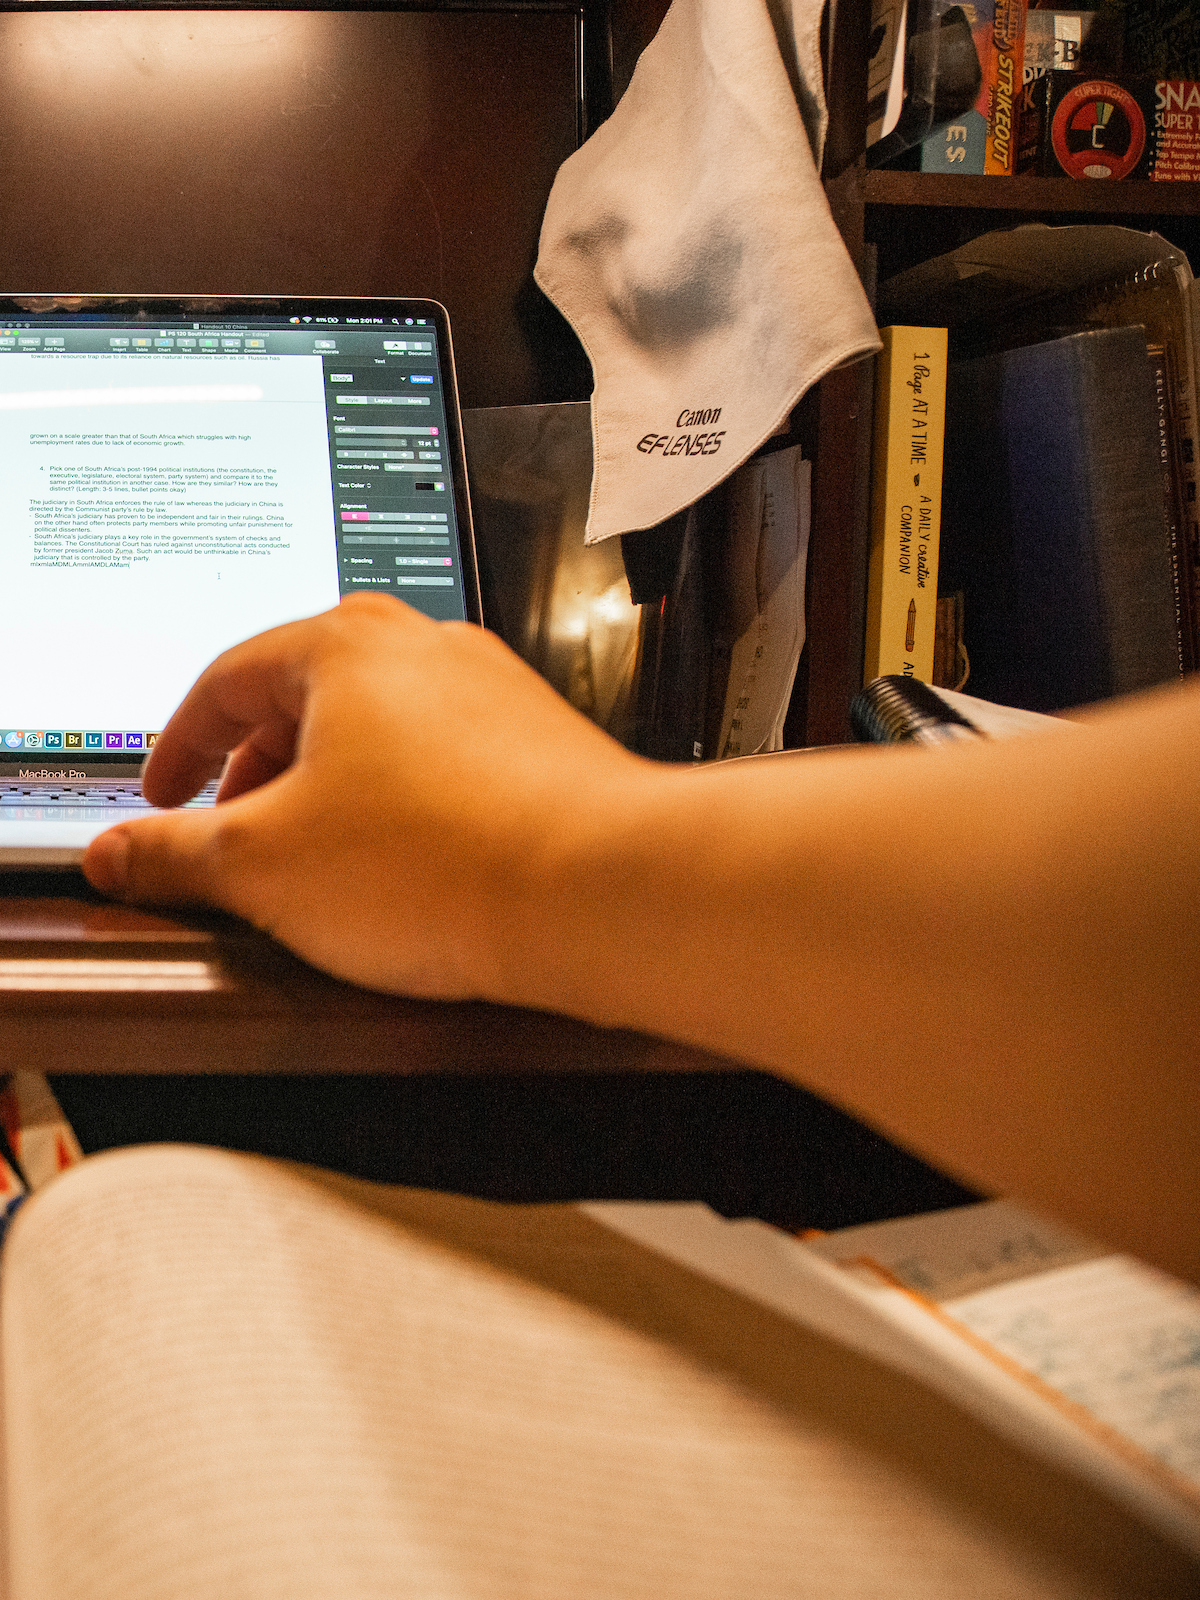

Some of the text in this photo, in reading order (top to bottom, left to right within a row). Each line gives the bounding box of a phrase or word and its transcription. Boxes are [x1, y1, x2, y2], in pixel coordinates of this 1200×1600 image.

[1074, 85, 1100, 98] SUPER
[994, 54, 1013, 169] STRIKEOUT
[1154, 112, 1192, 130] SUPER
[1157, 130, 1193, 142] Extremely
[1156, 139, 1171, 148] and
[1156, 150, 1193, 161] Tap Tempo
[1155, 160, 1168, 169] Pitch
[1155, 171, 1191, 181] Tune with
[907, 352, 930, 465] 1 Page AT A TIME
[676, 407, 722, 428] Canon
[899, 505, 913, 575] COMPANION
[916, 495, 932, 589] A DAILY creative
[1169, 524, 1179, 549] THE
[1171, 554, 1182, 624] ESSENTIAL
[47, 734, 60, 745] Ps
[68, 734, 79, 745] Br
[89, 734, 99, 745] Lr
[108, 734, 120, 745] Pr
[127, 734, 141, 745] Ae
[19, 769, 86, 780] MacBook Pro
